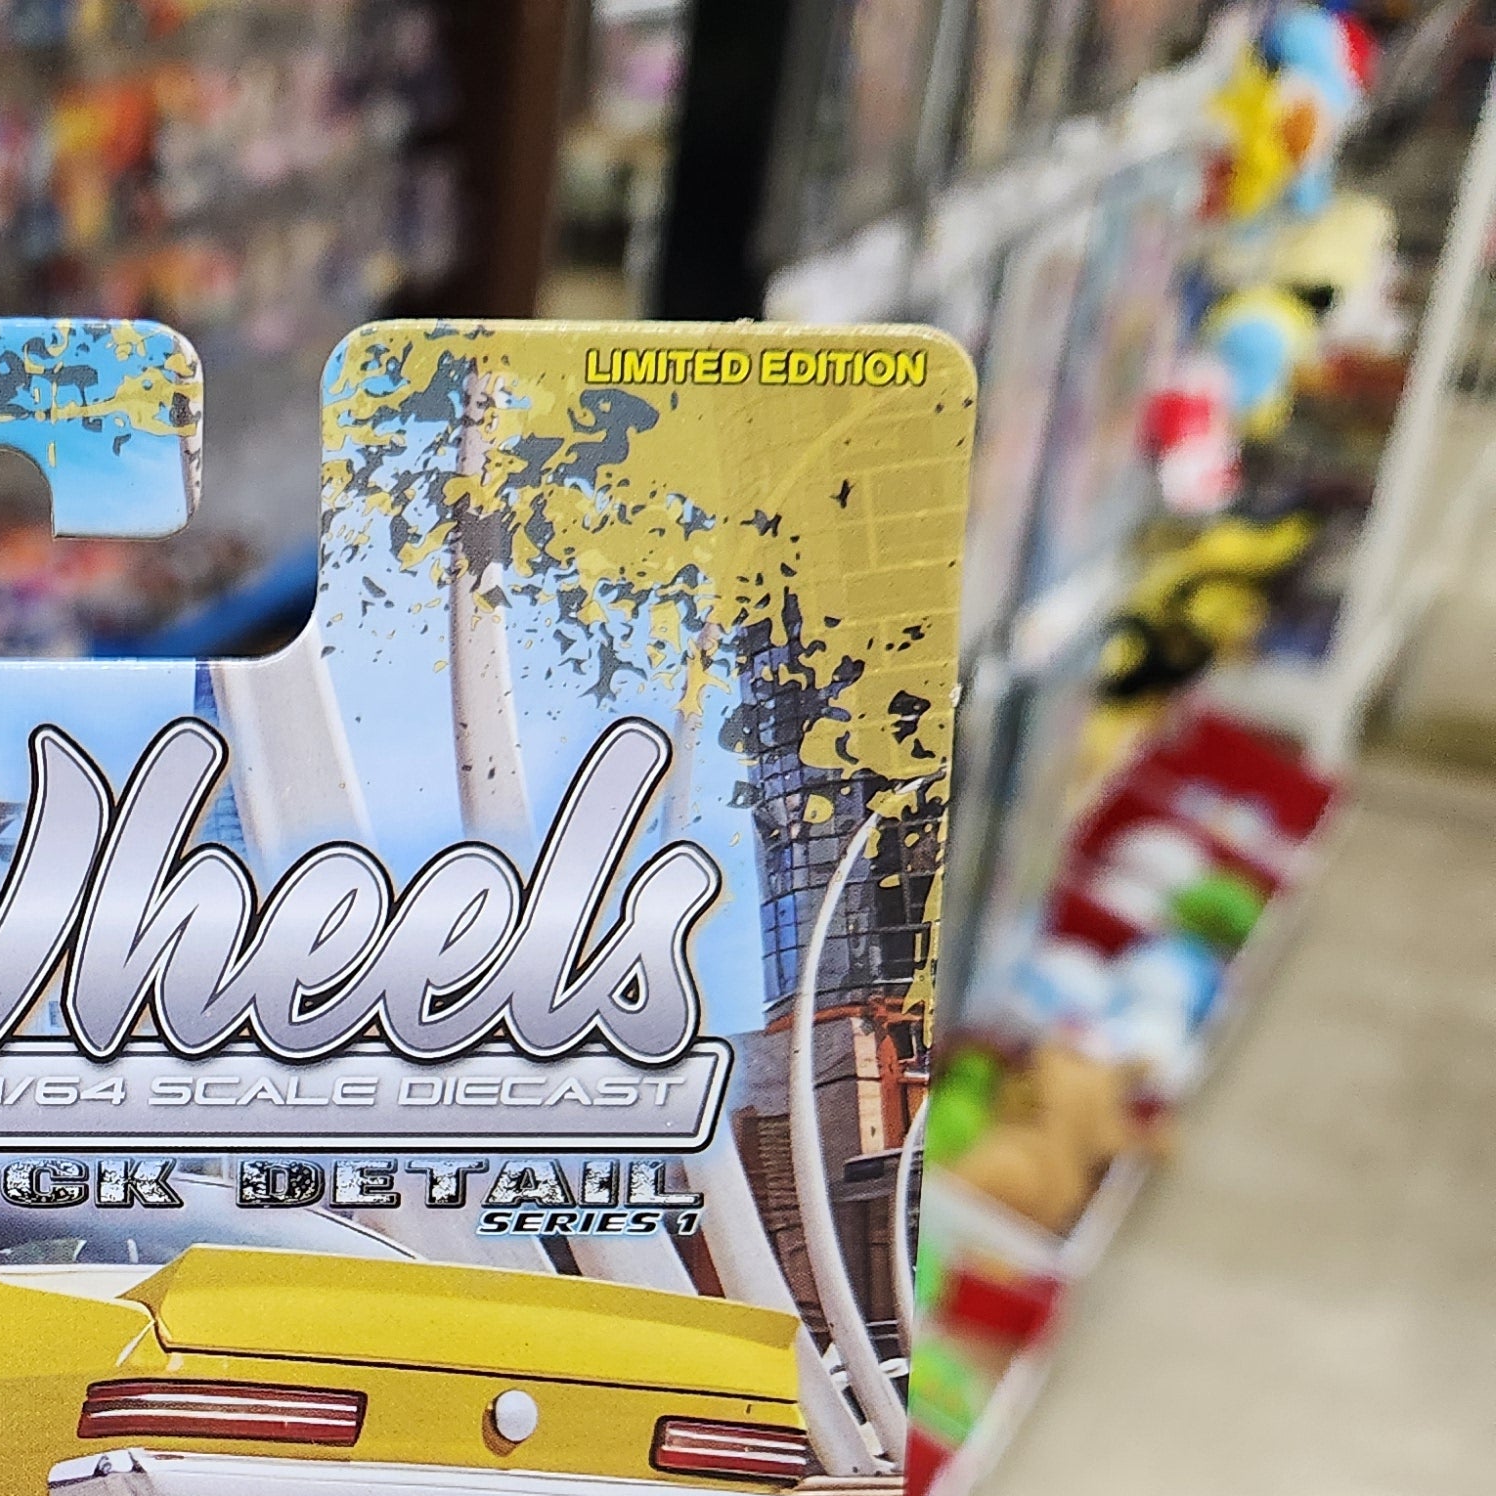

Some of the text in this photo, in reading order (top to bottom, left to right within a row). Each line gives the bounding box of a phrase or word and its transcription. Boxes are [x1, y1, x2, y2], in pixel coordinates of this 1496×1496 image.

[586, 348, 927, 386] LIMITED EDITION
[148, 1076, 379, 1106] SCALE
[398, 1076, 685, 1107] DIECAST
[235, 1157, 705, 1209] DETAIL
[478, 1211, 701, 1236] SERIES 1
